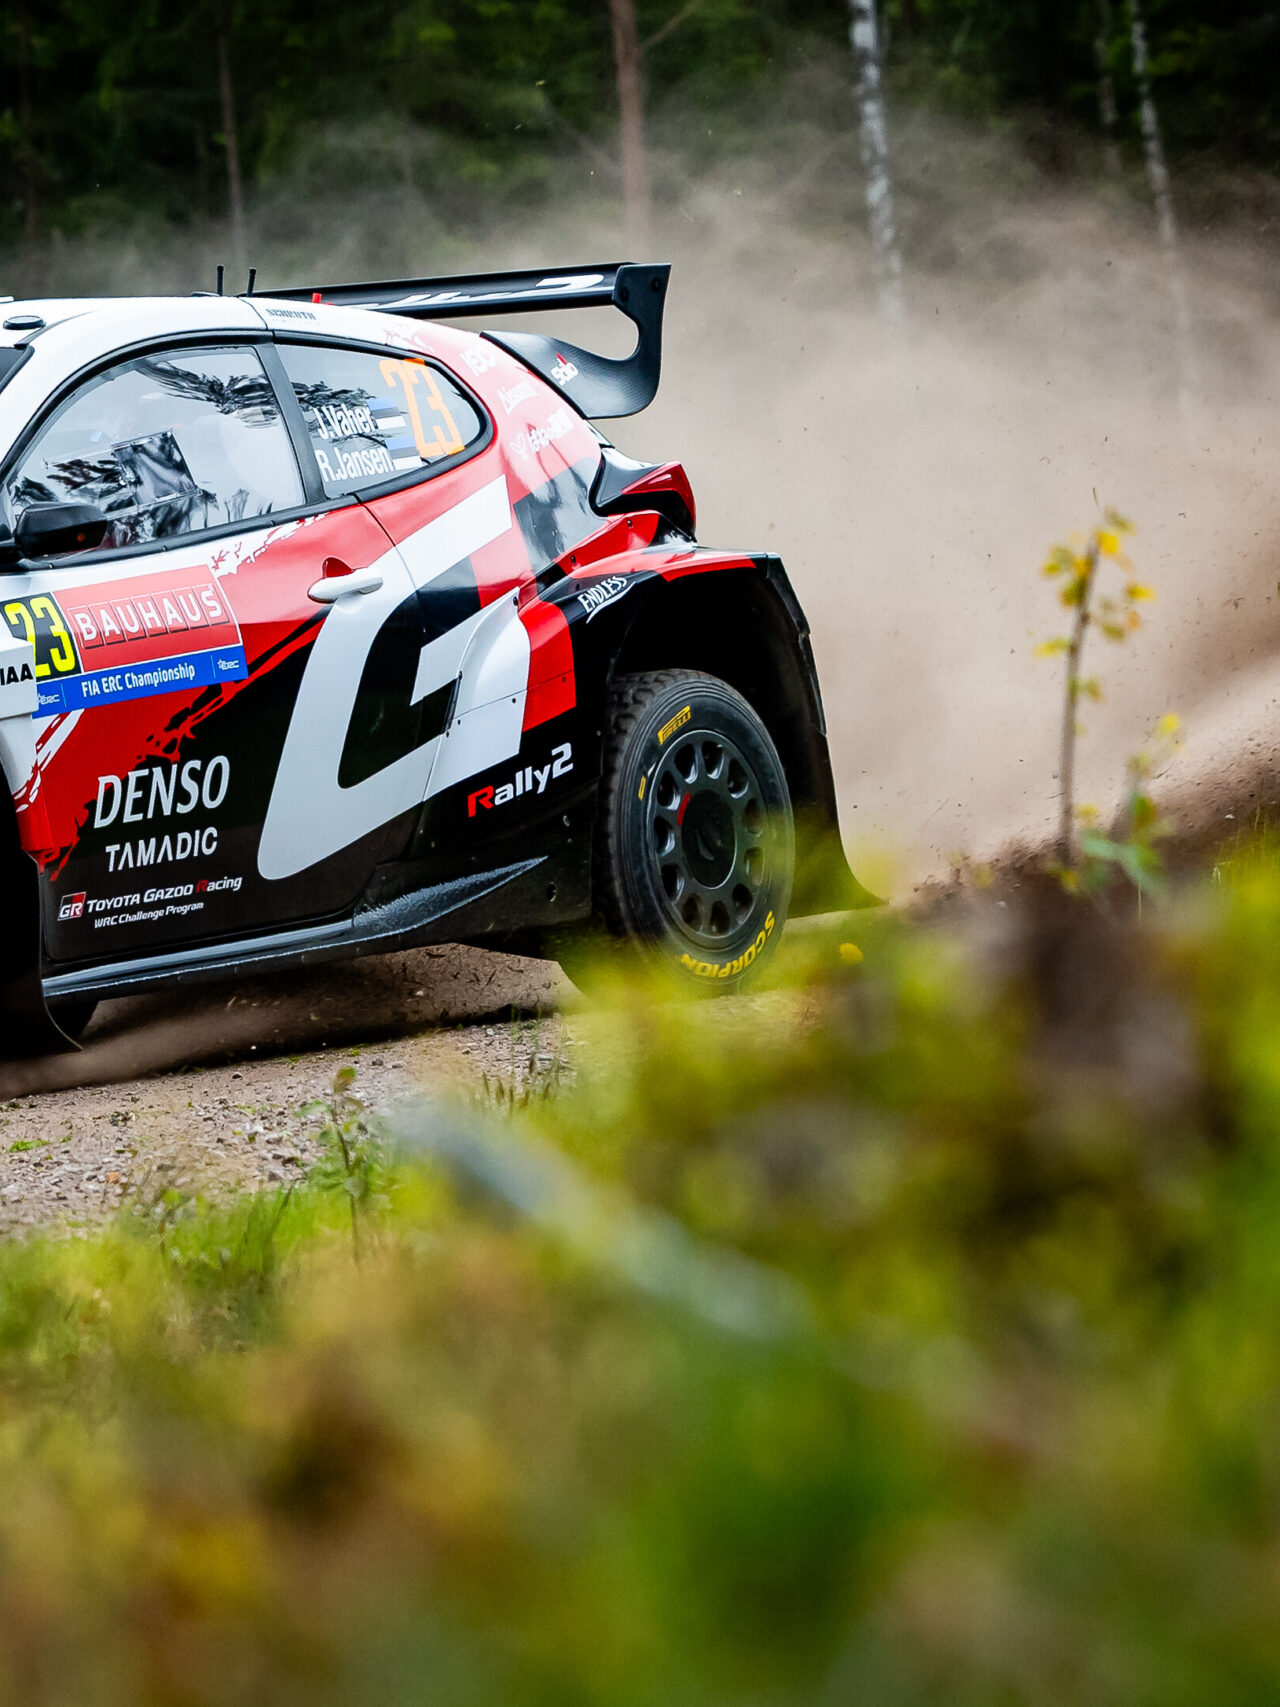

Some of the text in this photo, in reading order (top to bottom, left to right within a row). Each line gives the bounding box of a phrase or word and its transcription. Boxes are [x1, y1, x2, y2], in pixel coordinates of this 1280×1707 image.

[313, 403, 377, 440] J.Vaher
[379, 358, 465, 457] 23
[315, 447, 396, 483] R.Jansen
[74, 587, 224, 642] BAUHAUS
[577, 576, 628, 614] ENDLESS
[4, 596, 76, 677] 23
[81, 664, 196, 698] FIA ERC Championship
[93, 755, 231, 829] DENSO
[467, 742, 574, 818] Rally2
[105, 826, 218, 872] TAMADIC
[86, 893, 140, 913] TOYOTA
[143, 883, 194, 903] GAZOO
[196, 876, 243, 893] Racing
[94, 902, 204, 928] WRC Challenge Program
